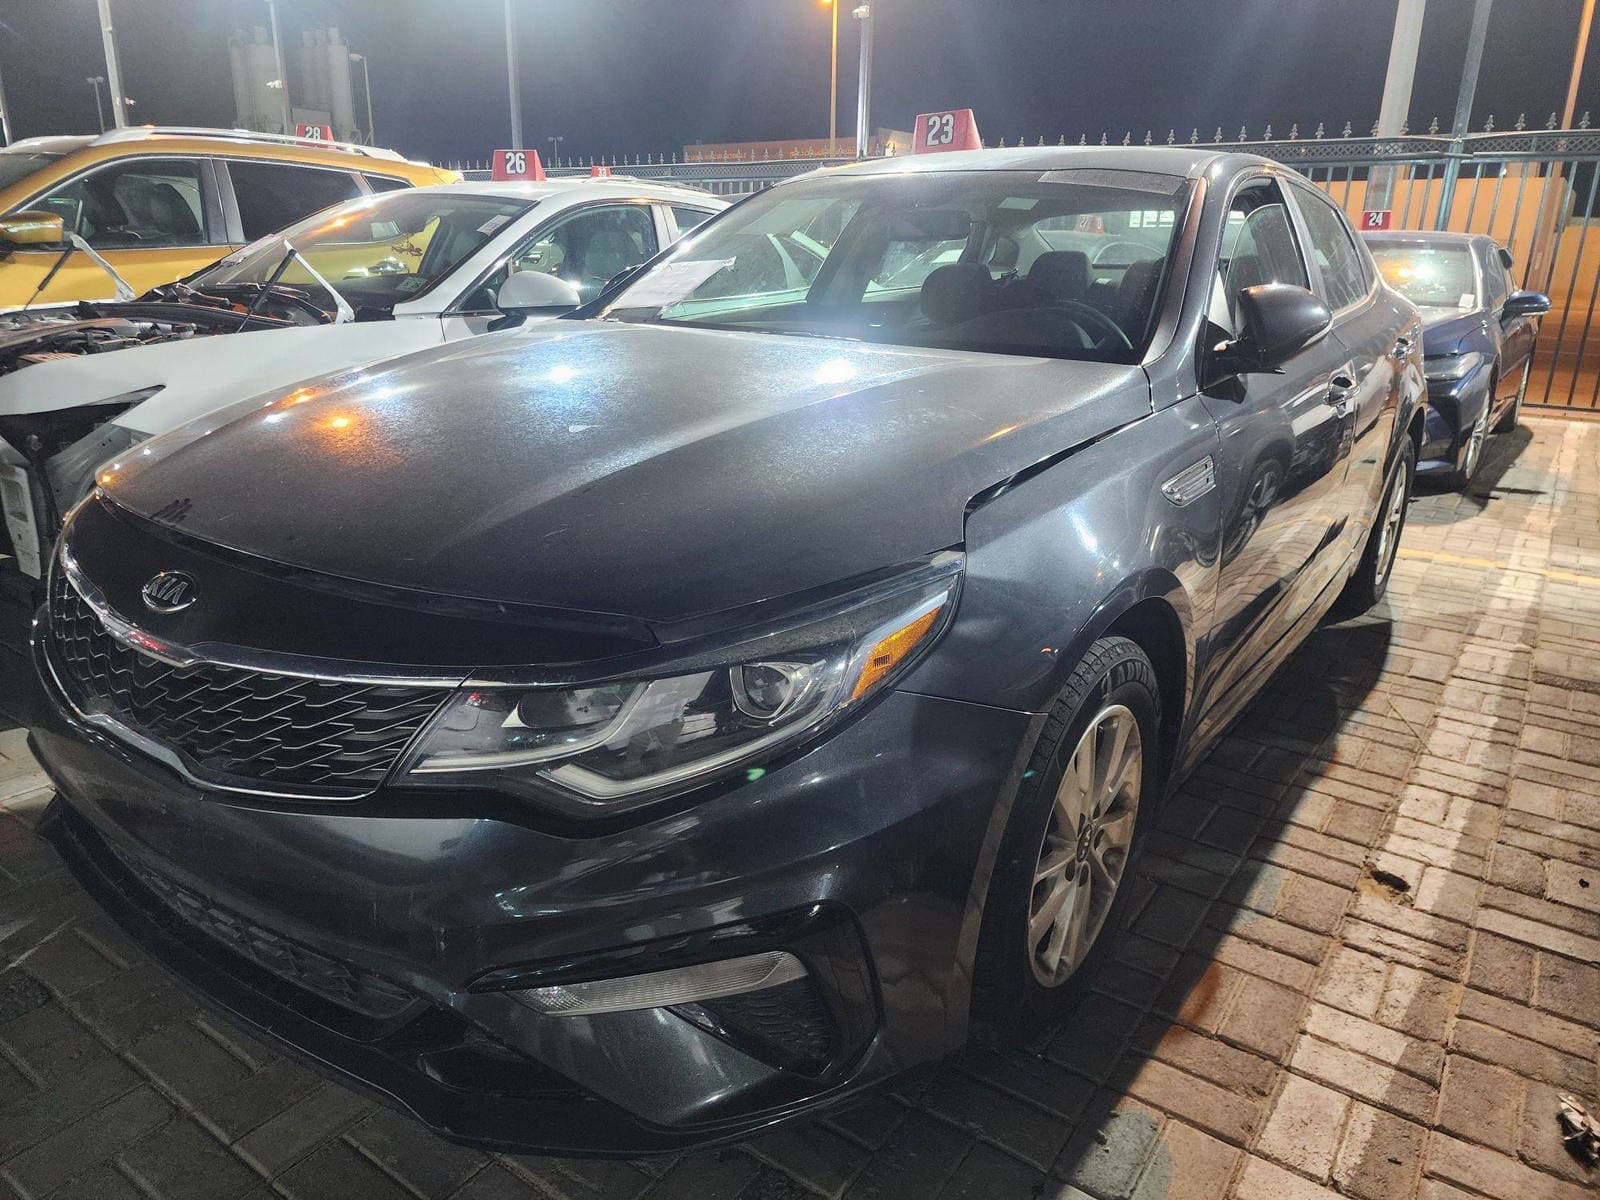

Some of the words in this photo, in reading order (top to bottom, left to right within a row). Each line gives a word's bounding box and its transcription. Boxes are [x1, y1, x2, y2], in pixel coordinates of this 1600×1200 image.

[304, 126, 321, 141] 28
[927, 114, 954, 146] 23
[505, 152, 526, 174] 26
[1368, 212, 1384, 226] 24
[147, 572, 189, 605] KIA
